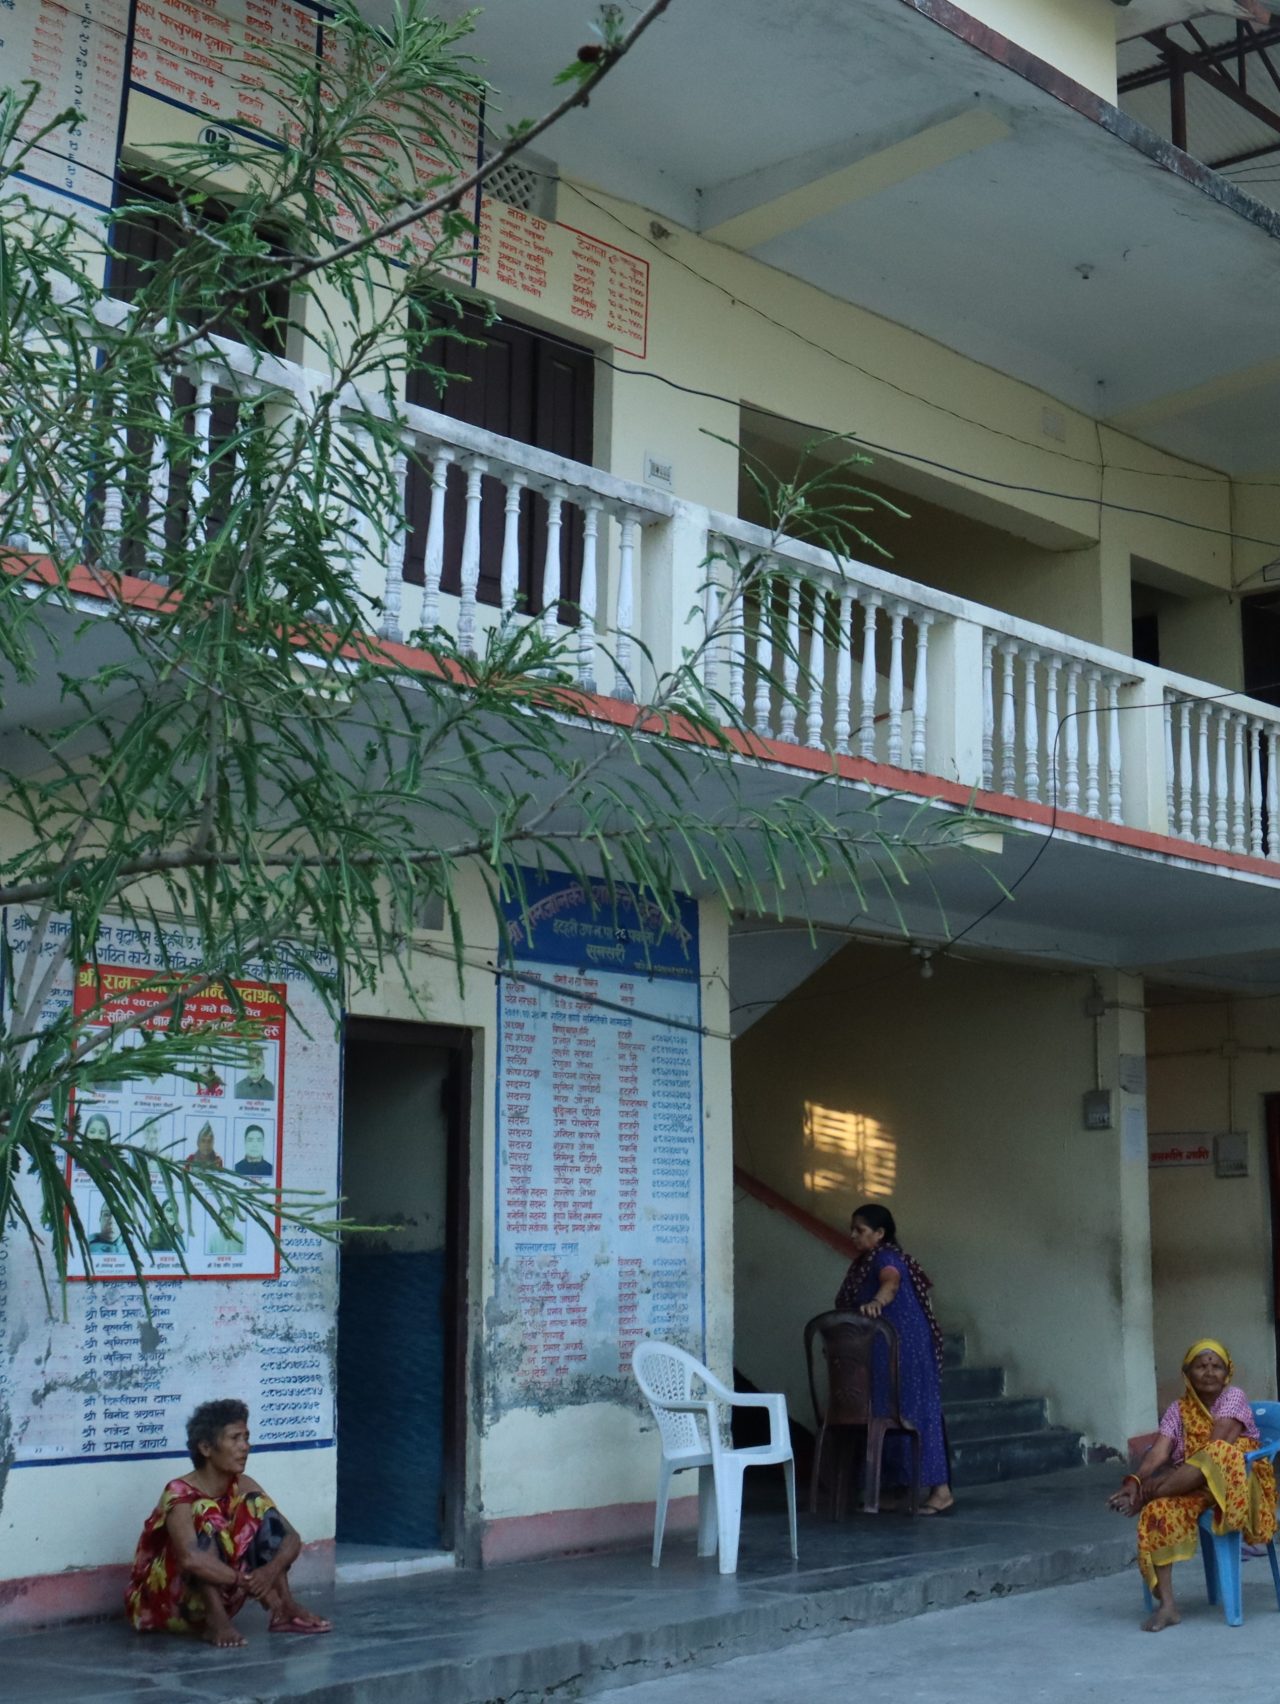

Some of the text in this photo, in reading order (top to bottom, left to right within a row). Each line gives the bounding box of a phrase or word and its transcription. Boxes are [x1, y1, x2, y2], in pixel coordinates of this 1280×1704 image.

[507, 207, 527, 222] नाम
[12, 914, 27, 931] श्री
[586, 943, 625, 964] सुनसरी
[79, 968, 97, 988] श्री
